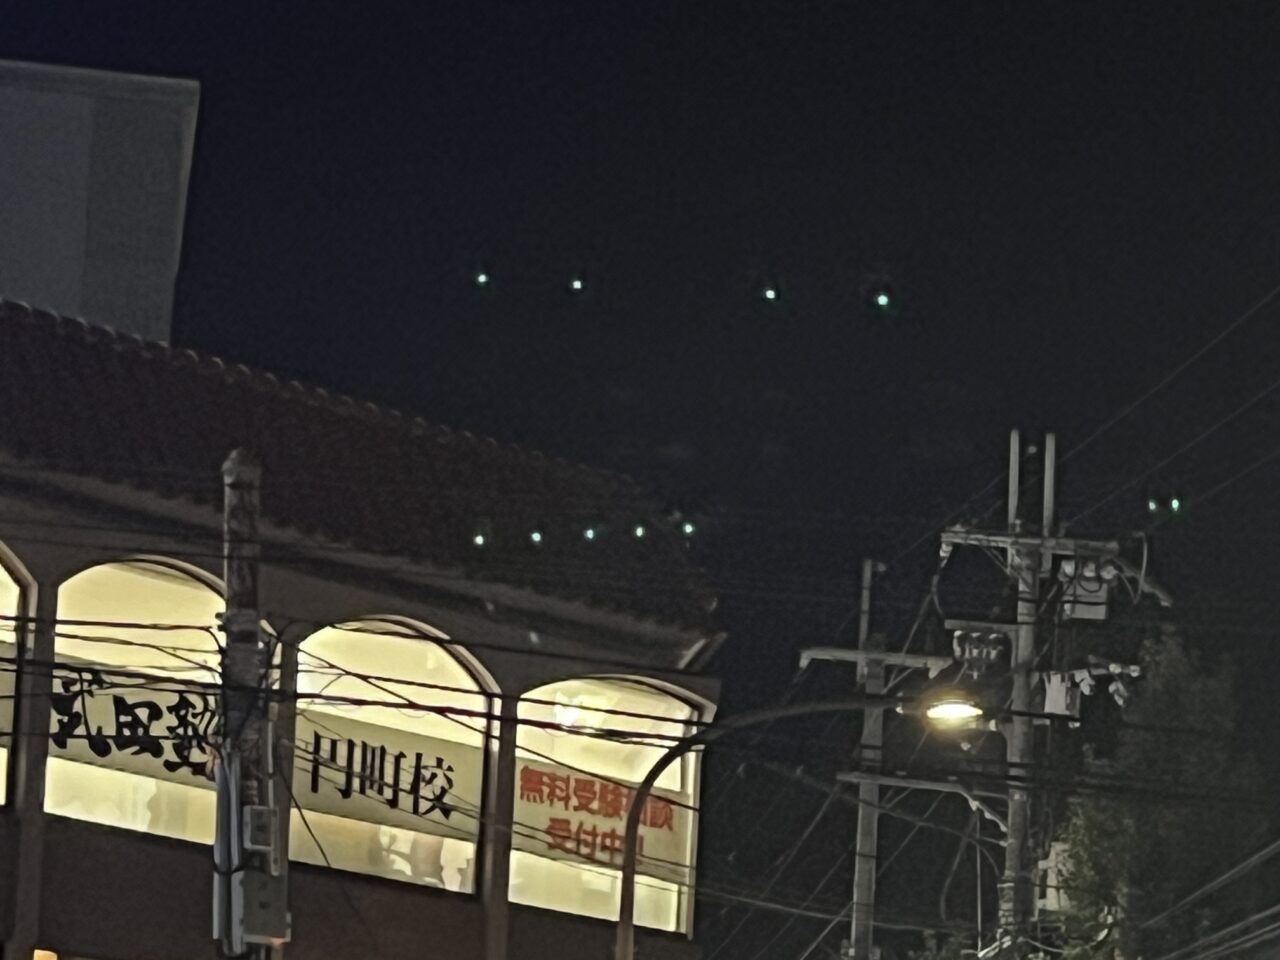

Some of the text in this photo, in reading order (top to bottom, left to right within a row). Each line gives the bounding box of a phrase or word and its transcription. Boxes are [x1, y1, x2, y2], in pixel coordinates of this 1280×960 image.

[311, 730, 455, 820] 円町校
[520, 765, 673, 831] 無料受験談
